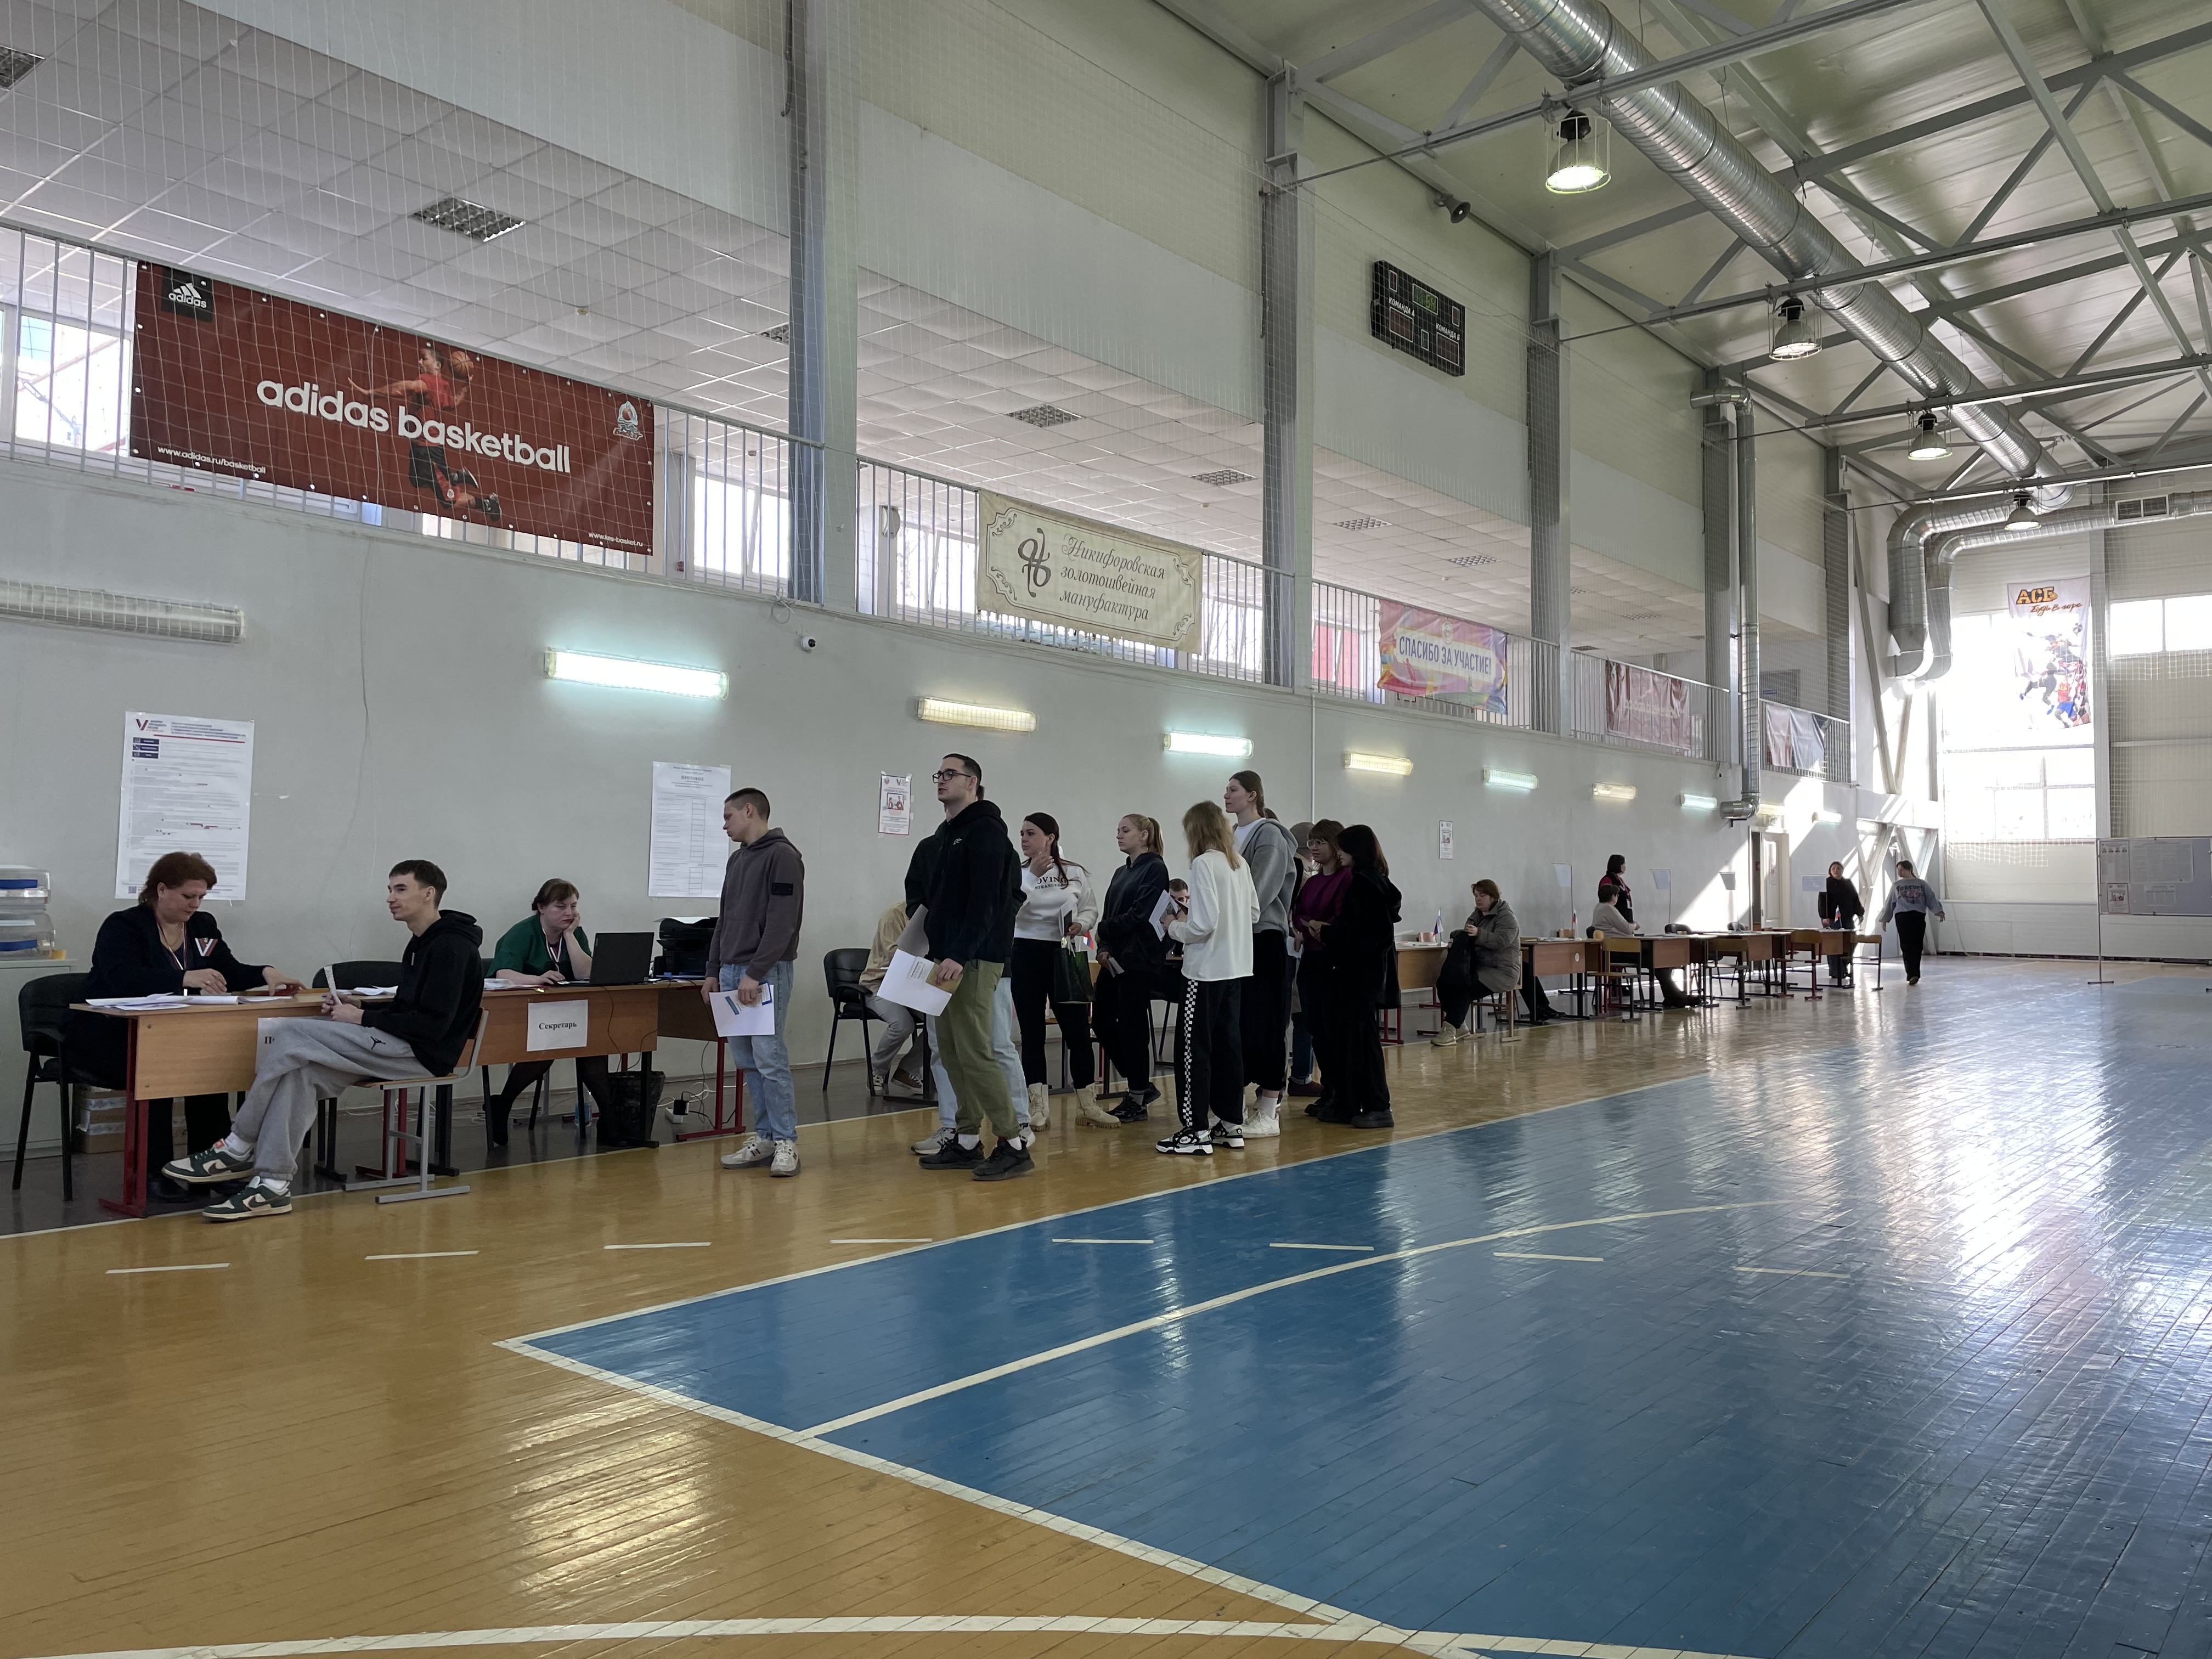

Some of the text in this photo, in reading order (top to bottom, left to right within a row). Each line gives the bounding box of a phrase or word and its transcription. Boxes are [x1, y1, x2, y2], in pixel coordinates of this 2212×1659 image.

[168, 292, 207, 308] adidas
[1389, 297, 1411, 315] КОМАНДА
[1411, 309, 1415, 317] А
[1436, 323, 1457, 339] КОМАНДА
[257, 380, 571, 473] adidas basketball
[157, 446, 266, 474] www.adidas.ru/basketball
[588, 532, 643, 547] www.kes-basket.ru
[1062, 533, 1165, 579] Никифоровская
[1060, 566, 1156, 599] золотошвейная
[1060, 589, 1149, 622] мануфактура
[1400, 636, 1491, 675] СПАСИБО ЗА УЧАСТИЕ!
[539, 1022, 577, 1031] Секретарь
